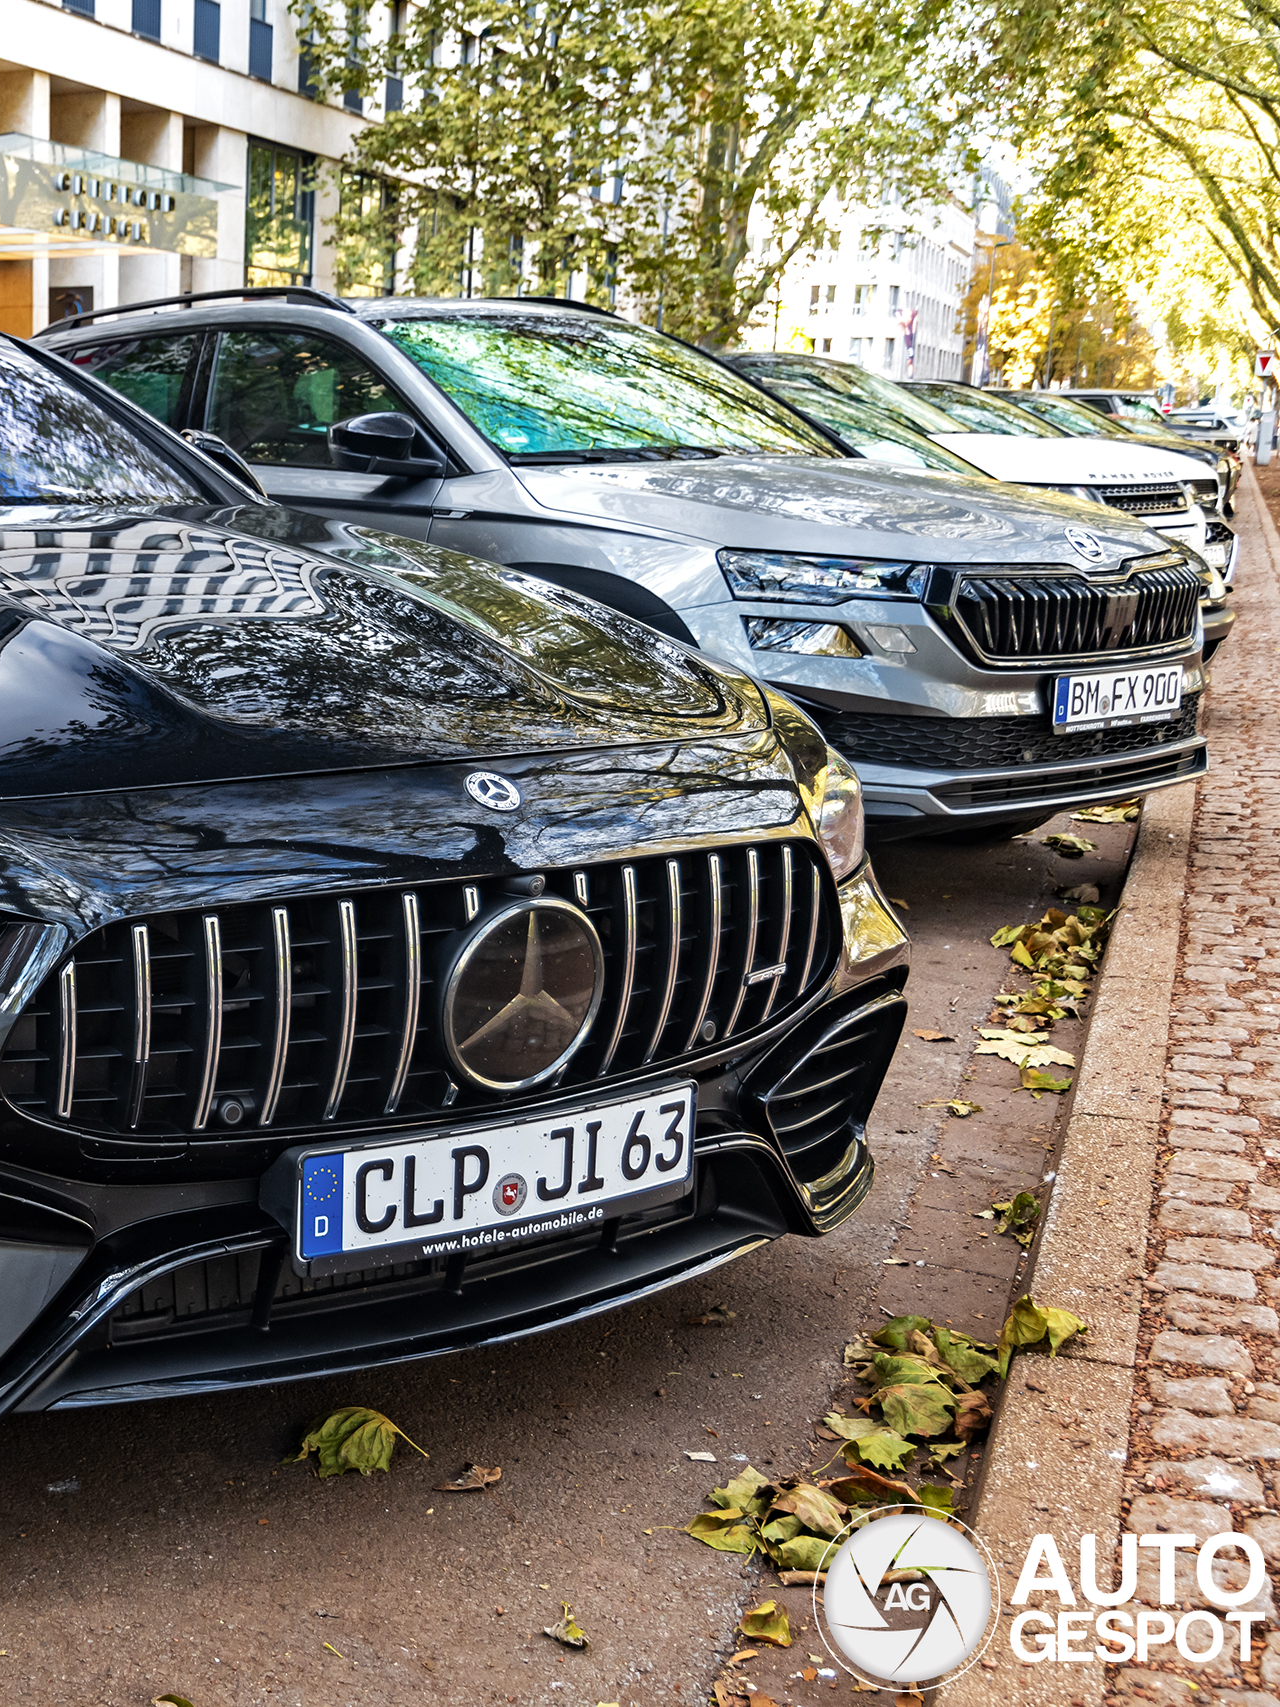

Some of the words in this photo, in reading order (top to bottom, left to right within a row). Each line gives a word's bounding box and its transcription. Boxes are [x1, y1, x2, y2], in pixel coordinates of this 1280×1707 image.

[1058, 705, 1065, 716] D
[1071, 680, 1100, 716] BM
[1111, 676, 1139, 712] FX
[1143, 671, 1178, 707] 900
[355, 1144, 490, 1234] CLP
[537, 1120, 605, 1202] JI
[621, 1099, 686, 1181] 63
[314, 1214, 329, 1238] D
[422, 1206, 604, 1255] www.hofele-automobile.de
